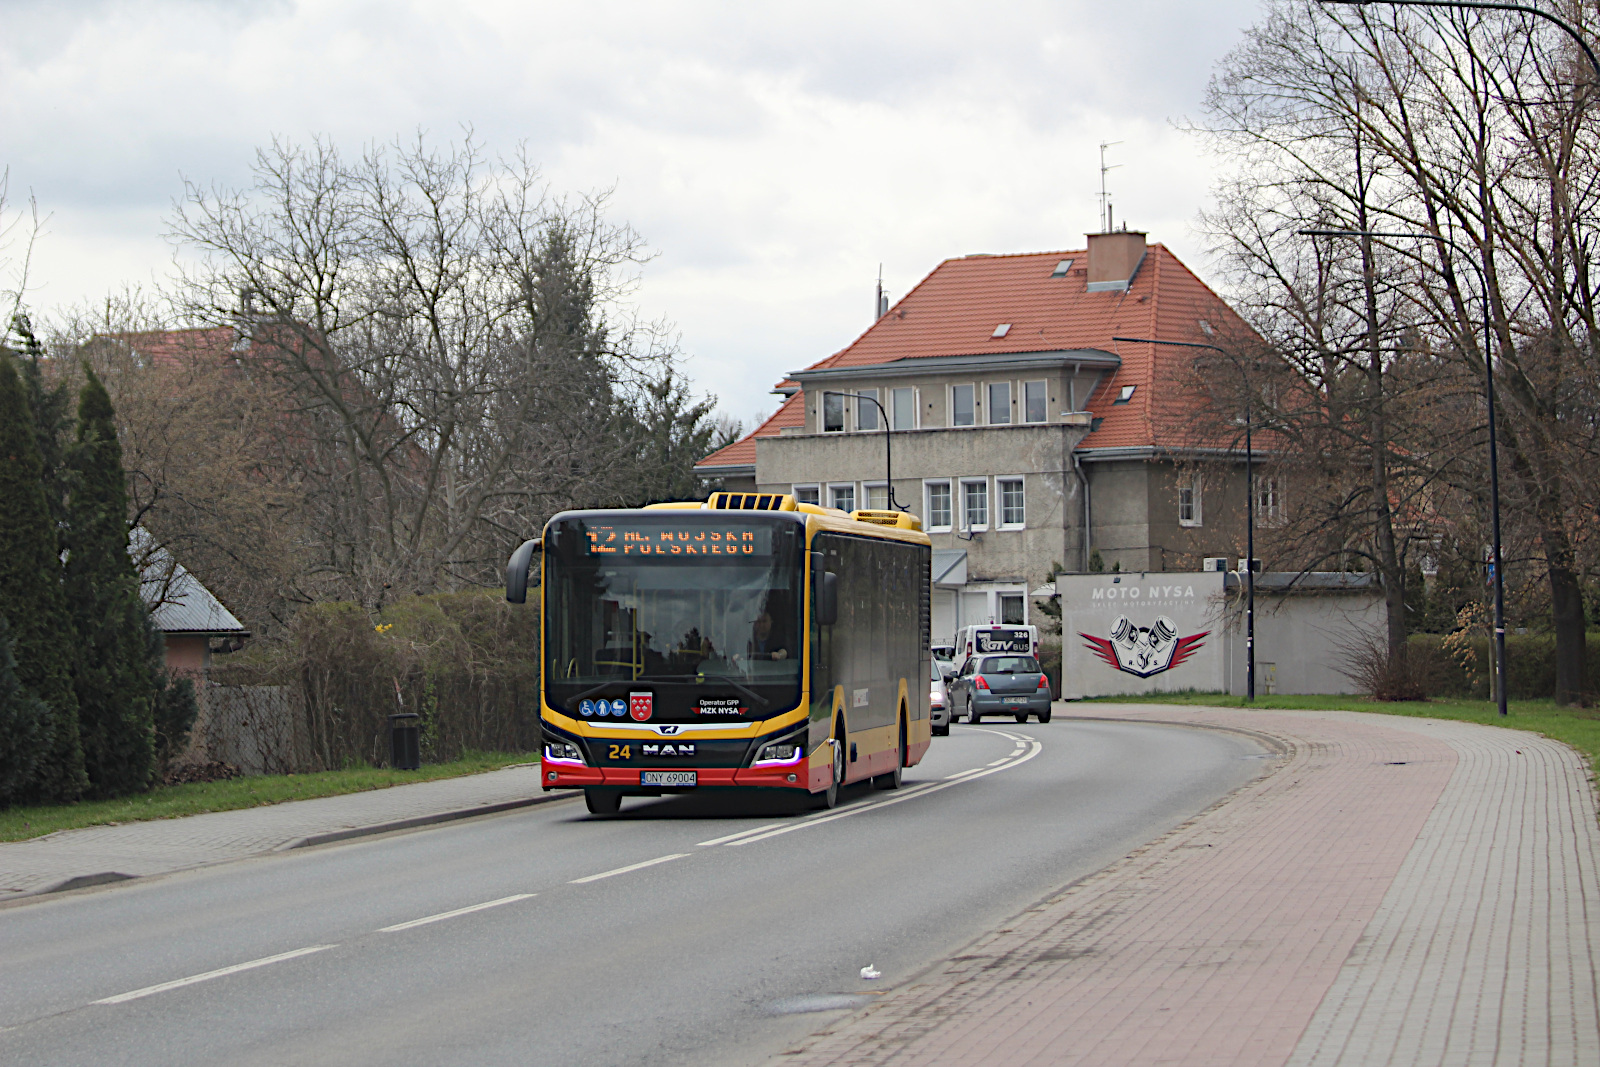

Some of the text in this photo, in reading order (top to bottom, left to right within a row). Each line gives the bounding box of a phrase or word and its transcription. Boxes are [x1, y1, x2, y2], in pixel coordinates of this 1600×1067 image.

[1092, 586, 1194, 599] MOTO NYSA
[988, 641, 1014, 650] GTV
[699, 699, 726, 707] Operator
[700, 707, 739, 715] MZK NYSA
[609, 744, 631, 759] 24
[642, 744, 695, 756] MAN
[645, 771, 696, 783] ONY 69004
